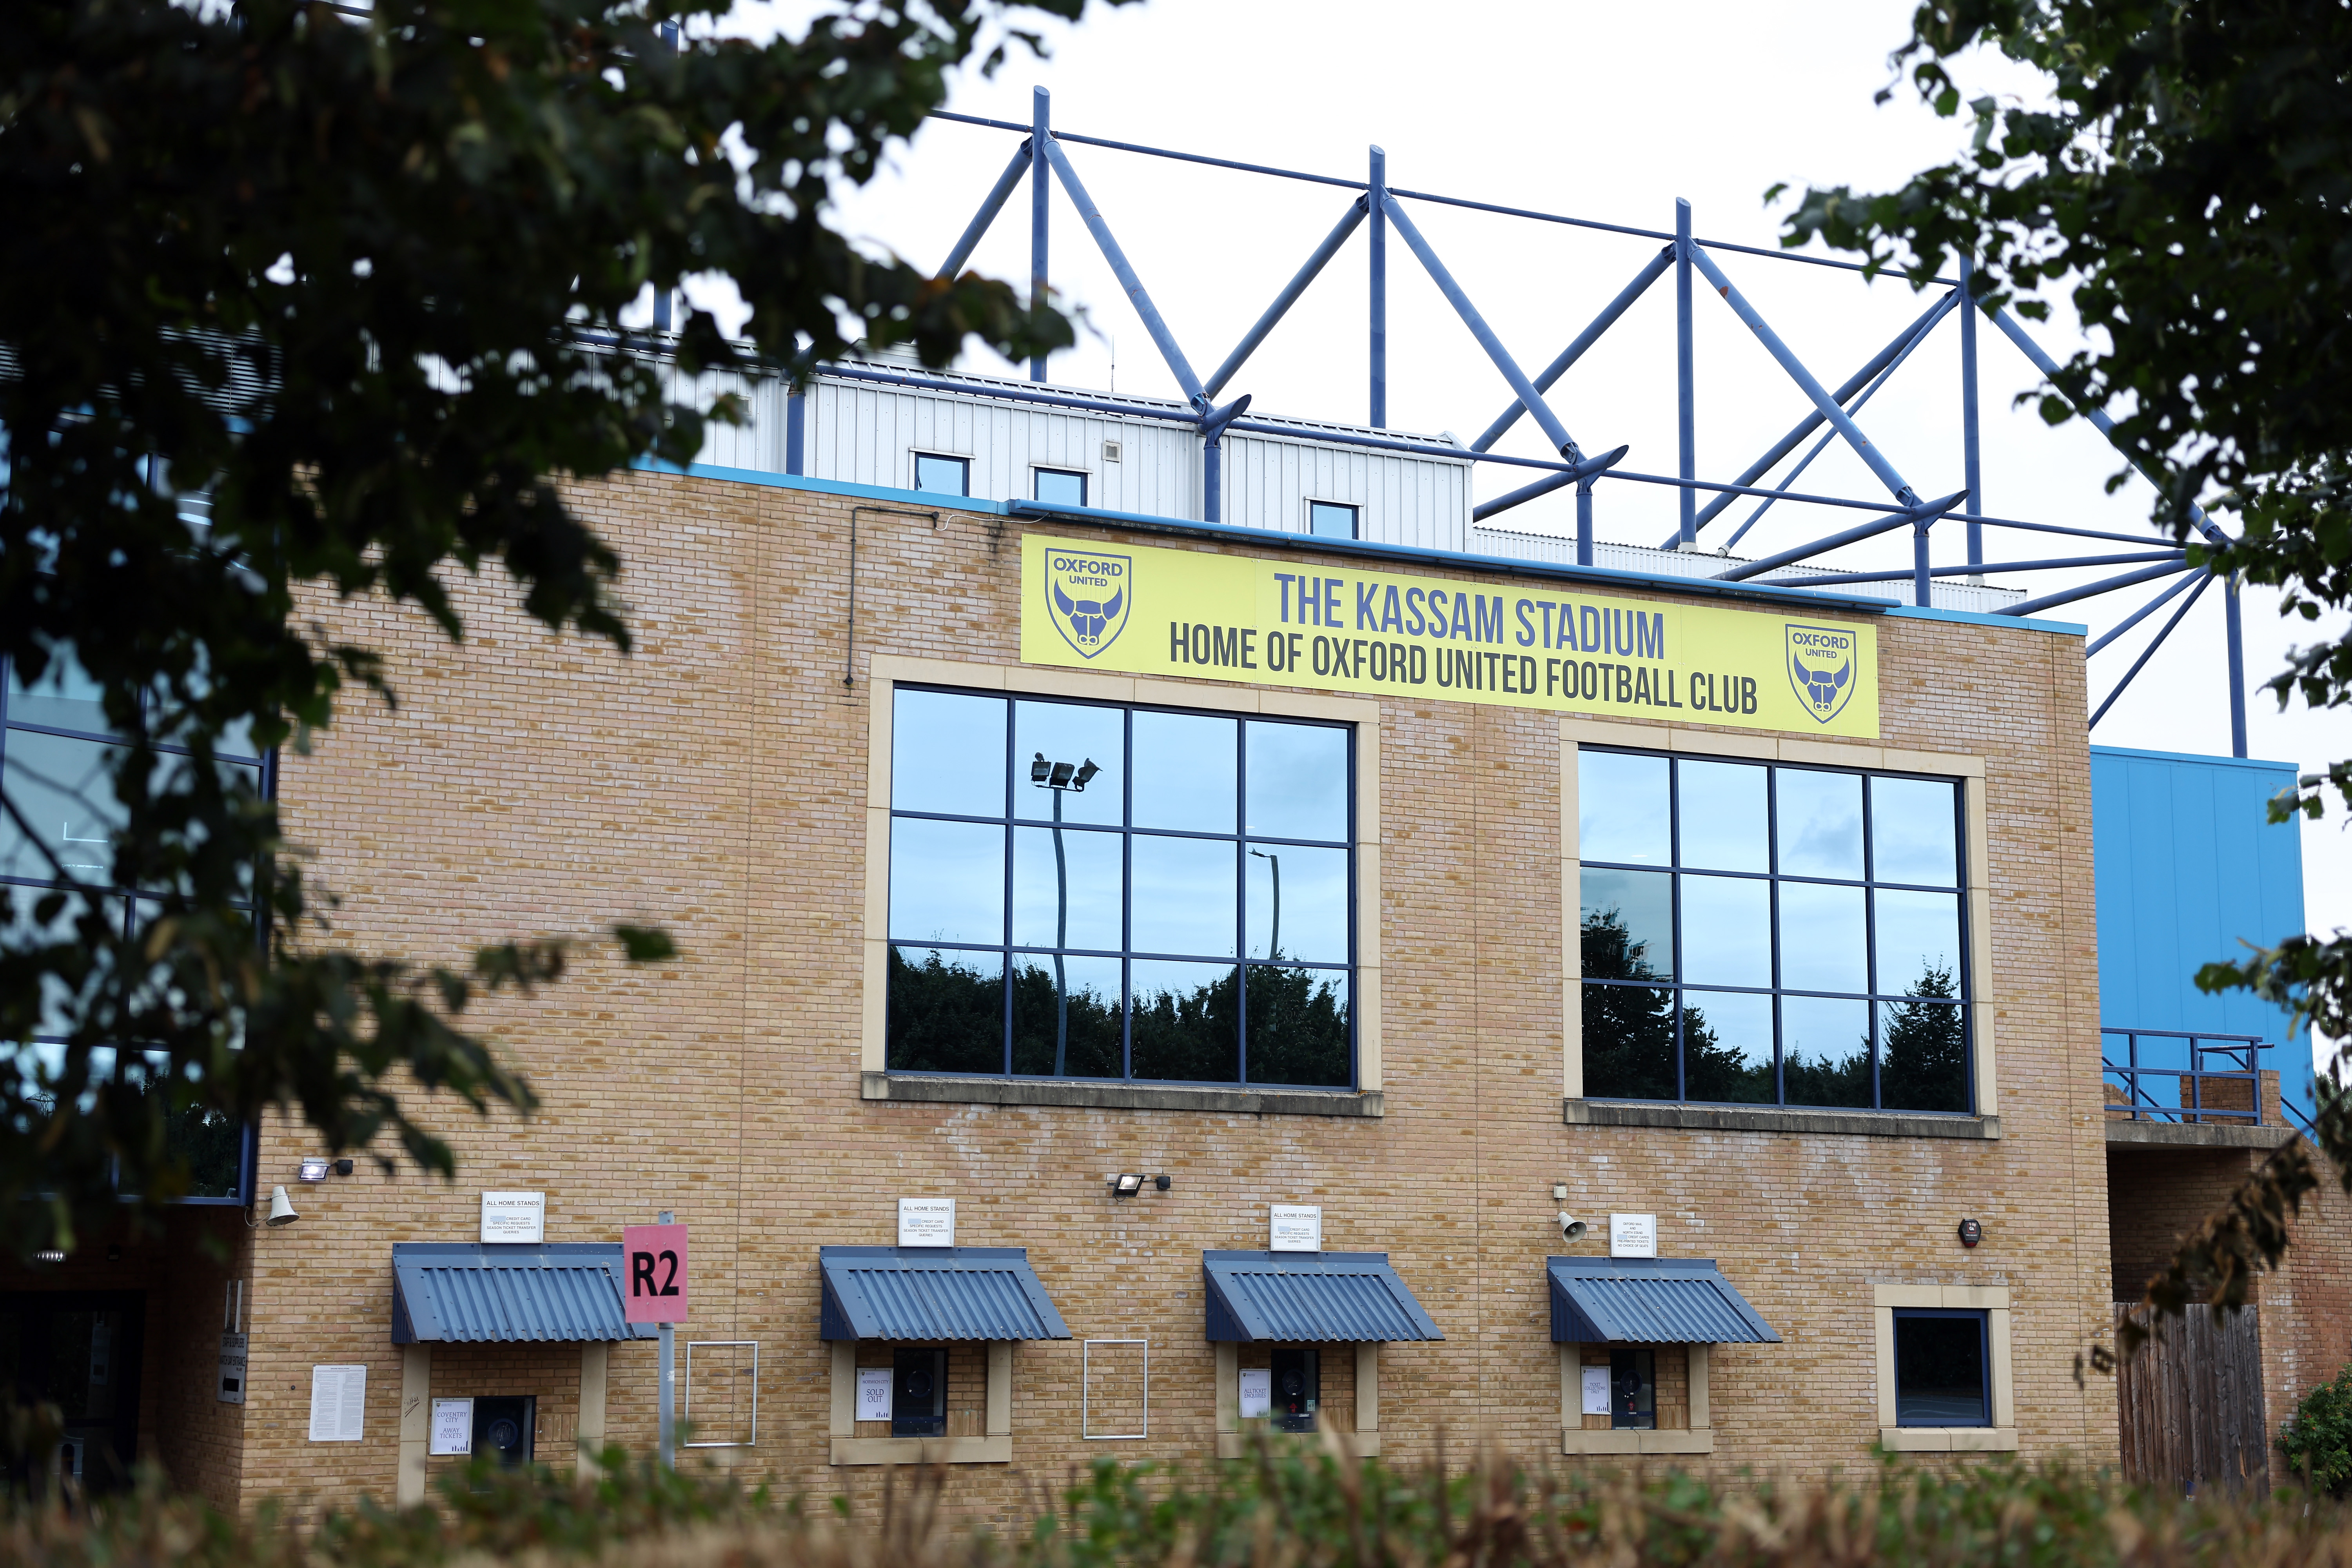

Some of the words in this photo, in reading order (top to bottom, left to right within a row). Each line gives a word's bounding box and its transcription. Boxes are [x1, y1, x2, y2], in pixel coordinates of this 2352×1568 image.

[1054, 557, 1123, 577] OXFORD
[1069, 575, 1107, 587] UNITED
[1274, 573, 1343, 628] THE
[1356, 582, 1503, 644] KASSAM
[1515, 599, 1664, 659] STADIUM
[1793, 632, 1849, 649] OXFORD
[1806, 648, 1837, 659] UNITED
[1171, 621, 1257, 669] HOME
[1267, 631, 1303, 673] OF
[1312, 635, 1426, 684] OXFORD
[1437, 648, 1537, 694] UNITED
[1547, 658, 1682, 708] FOOTBALL
[1690, 671, 1757, 714] CLUB
[633, 1250, 679, 1297] R2
[232, 1338, 245, 1348] SUPPLIERS
[233, 1356, 245, 1367] ENTRANCE
